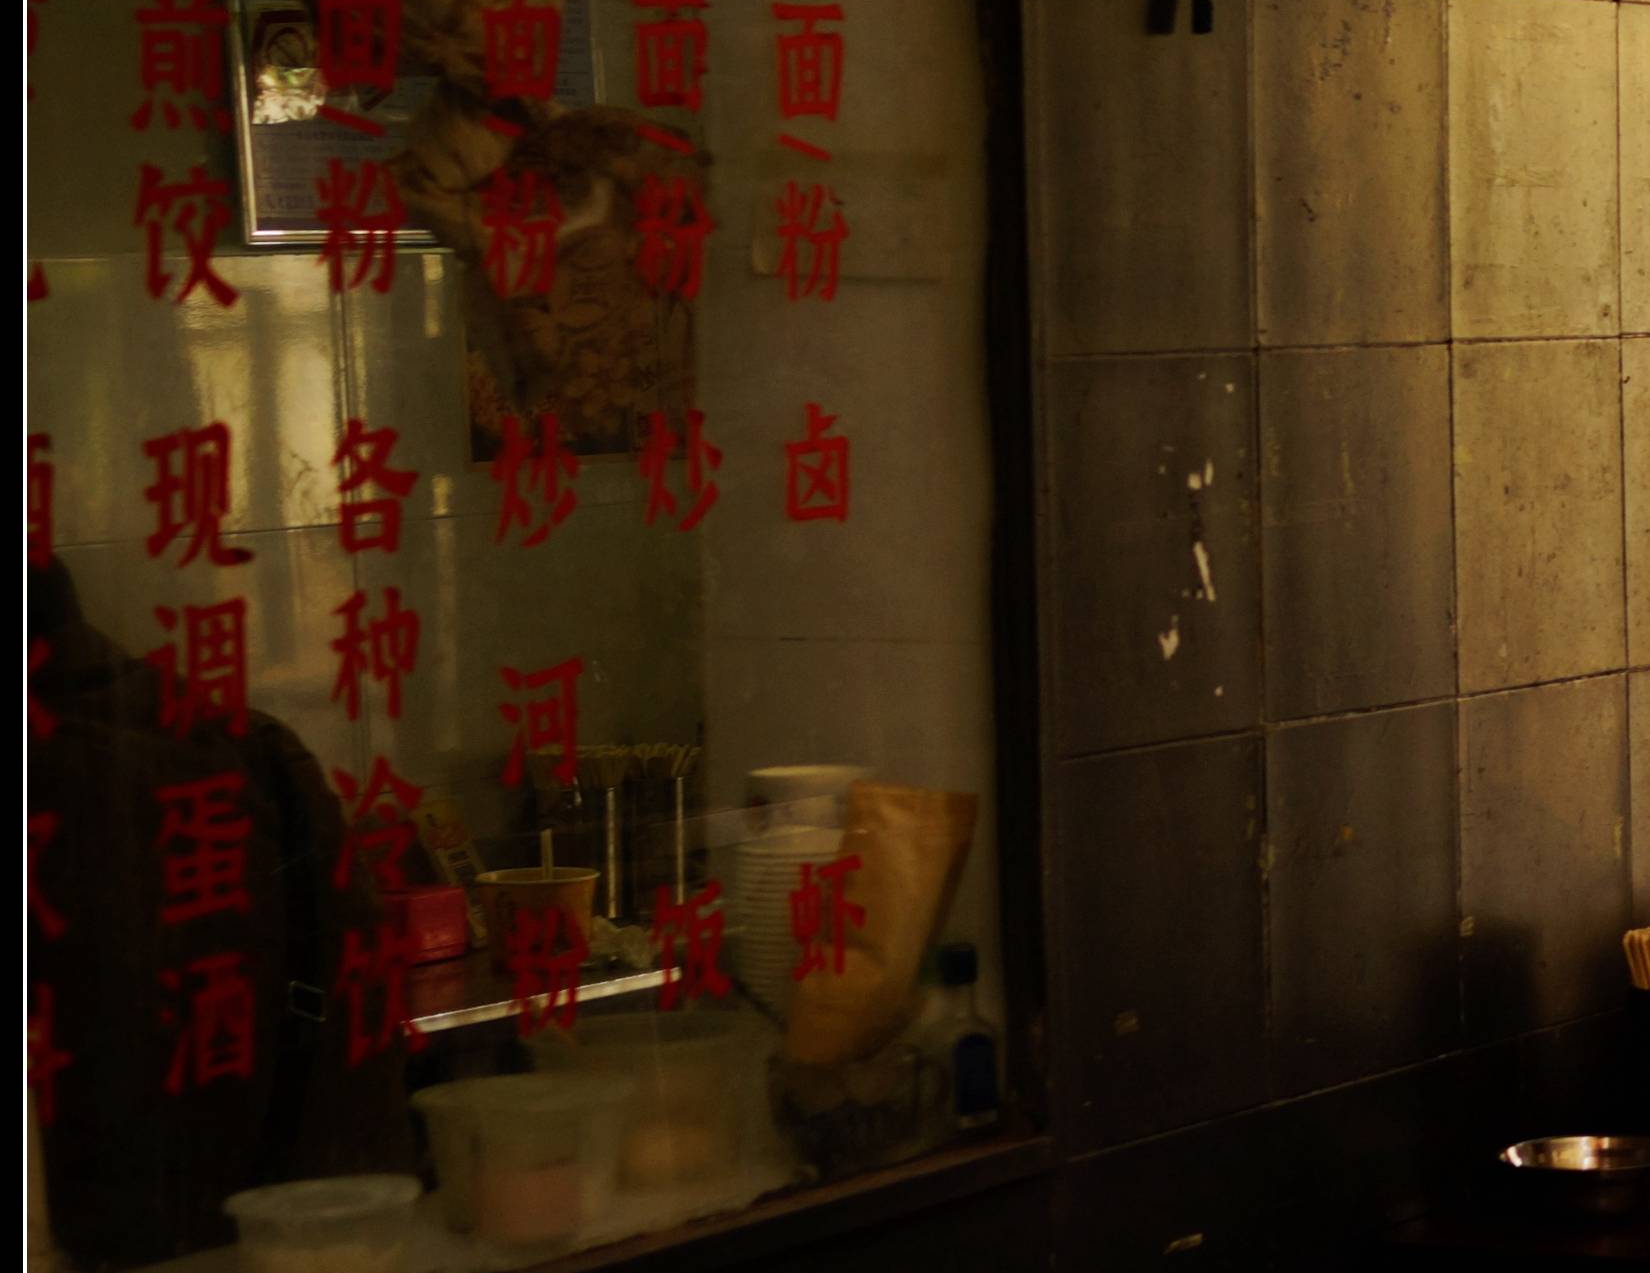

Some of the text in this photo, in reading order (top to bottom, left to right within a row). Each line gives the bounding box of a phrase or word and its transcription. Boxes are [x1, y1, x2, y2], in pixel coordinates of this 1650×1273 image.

[144, 421, 256, 1098] 现调蛋酒
[330, 419, 428, 1070] 各种冷饮
